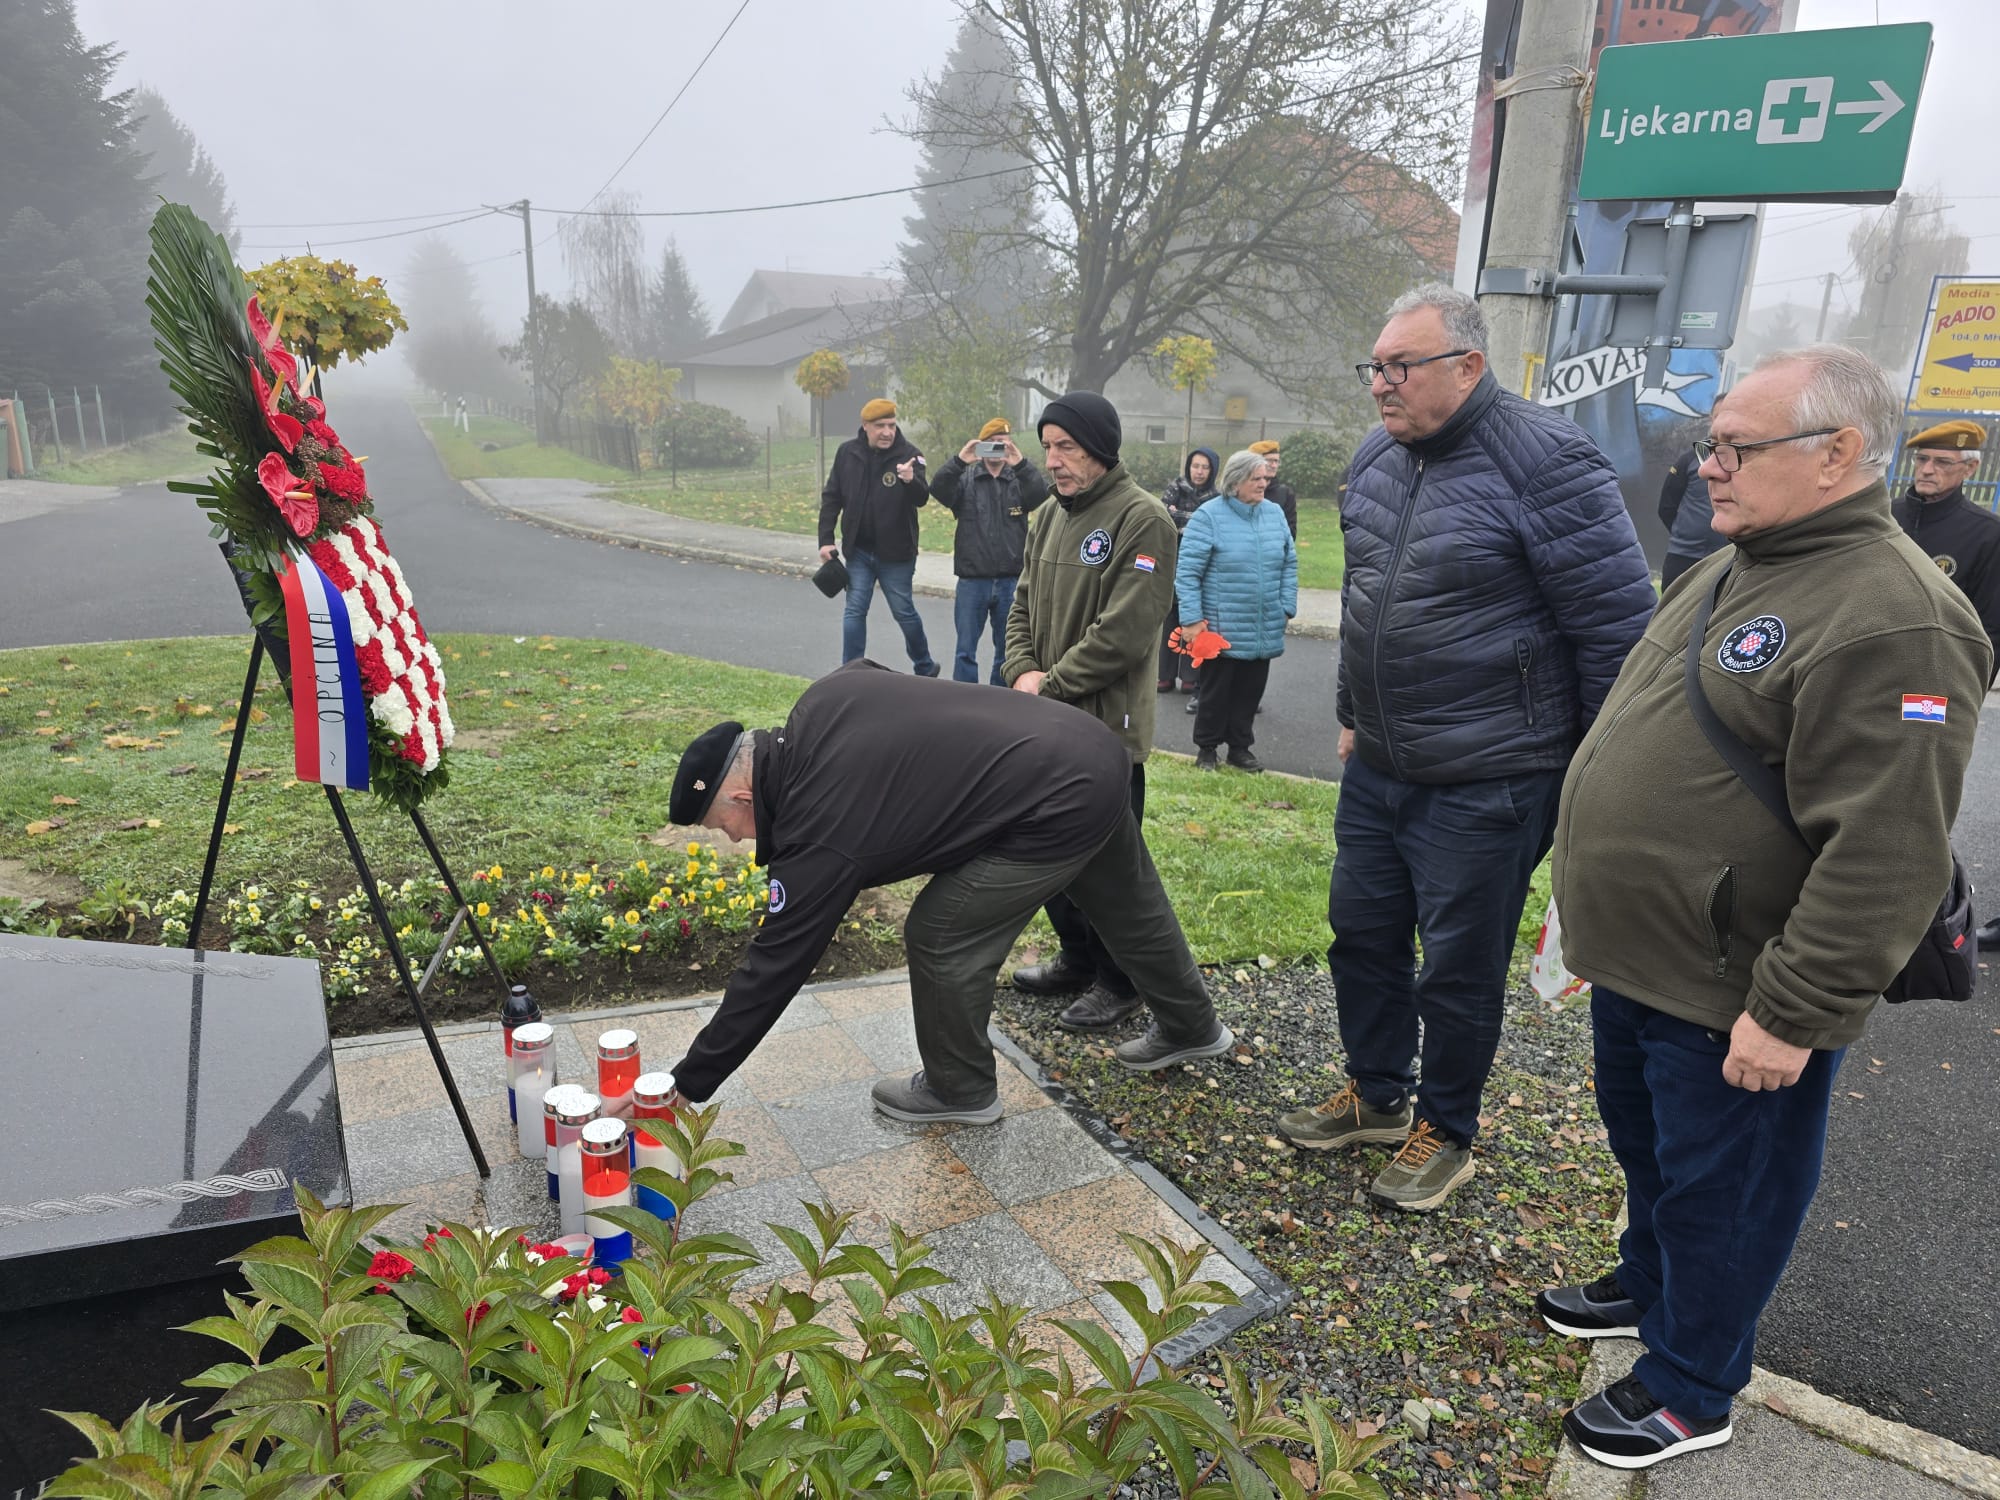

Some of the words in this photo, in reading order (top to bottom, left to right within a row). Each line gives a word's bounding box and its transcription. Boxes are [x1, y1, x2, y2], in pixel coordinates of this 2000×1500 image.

[1600, 104, 1753, 145] Ljekarna
[1947, 289, 1990, 298] Media
[1935, 305, 1996, 334] RADIO
[1973, 359, 1997, 367] 300
[1742, 620, 1762, 633] HOS
[1762, 620, 1779, 645] BELICA
